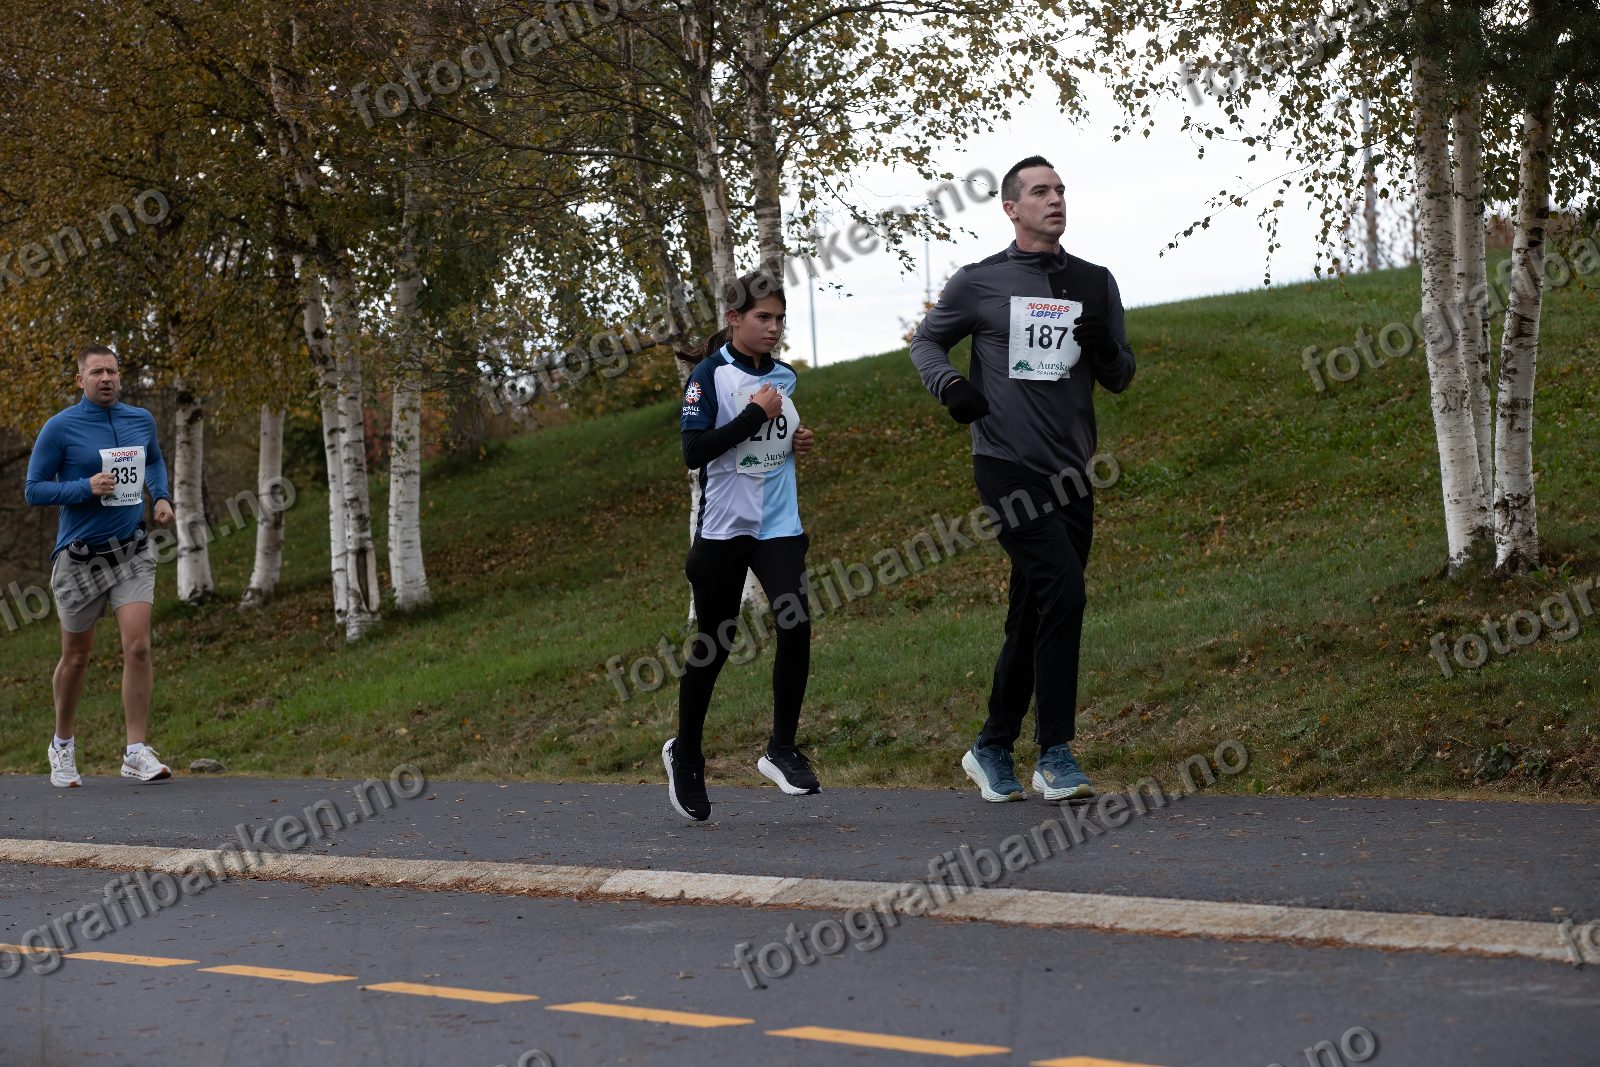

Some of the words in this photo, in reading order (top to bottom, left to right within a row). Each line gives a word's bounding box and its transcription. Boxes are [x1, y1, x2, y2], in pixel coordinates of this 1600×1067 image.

[1027, 302, 1070, 313] NORGES
[1031, 309, 1063, 319] LØPET
[1025, 323, 1069, 350] 187
[750, 414, 788, 442] 79
[110, 466, 138, 485] 335
